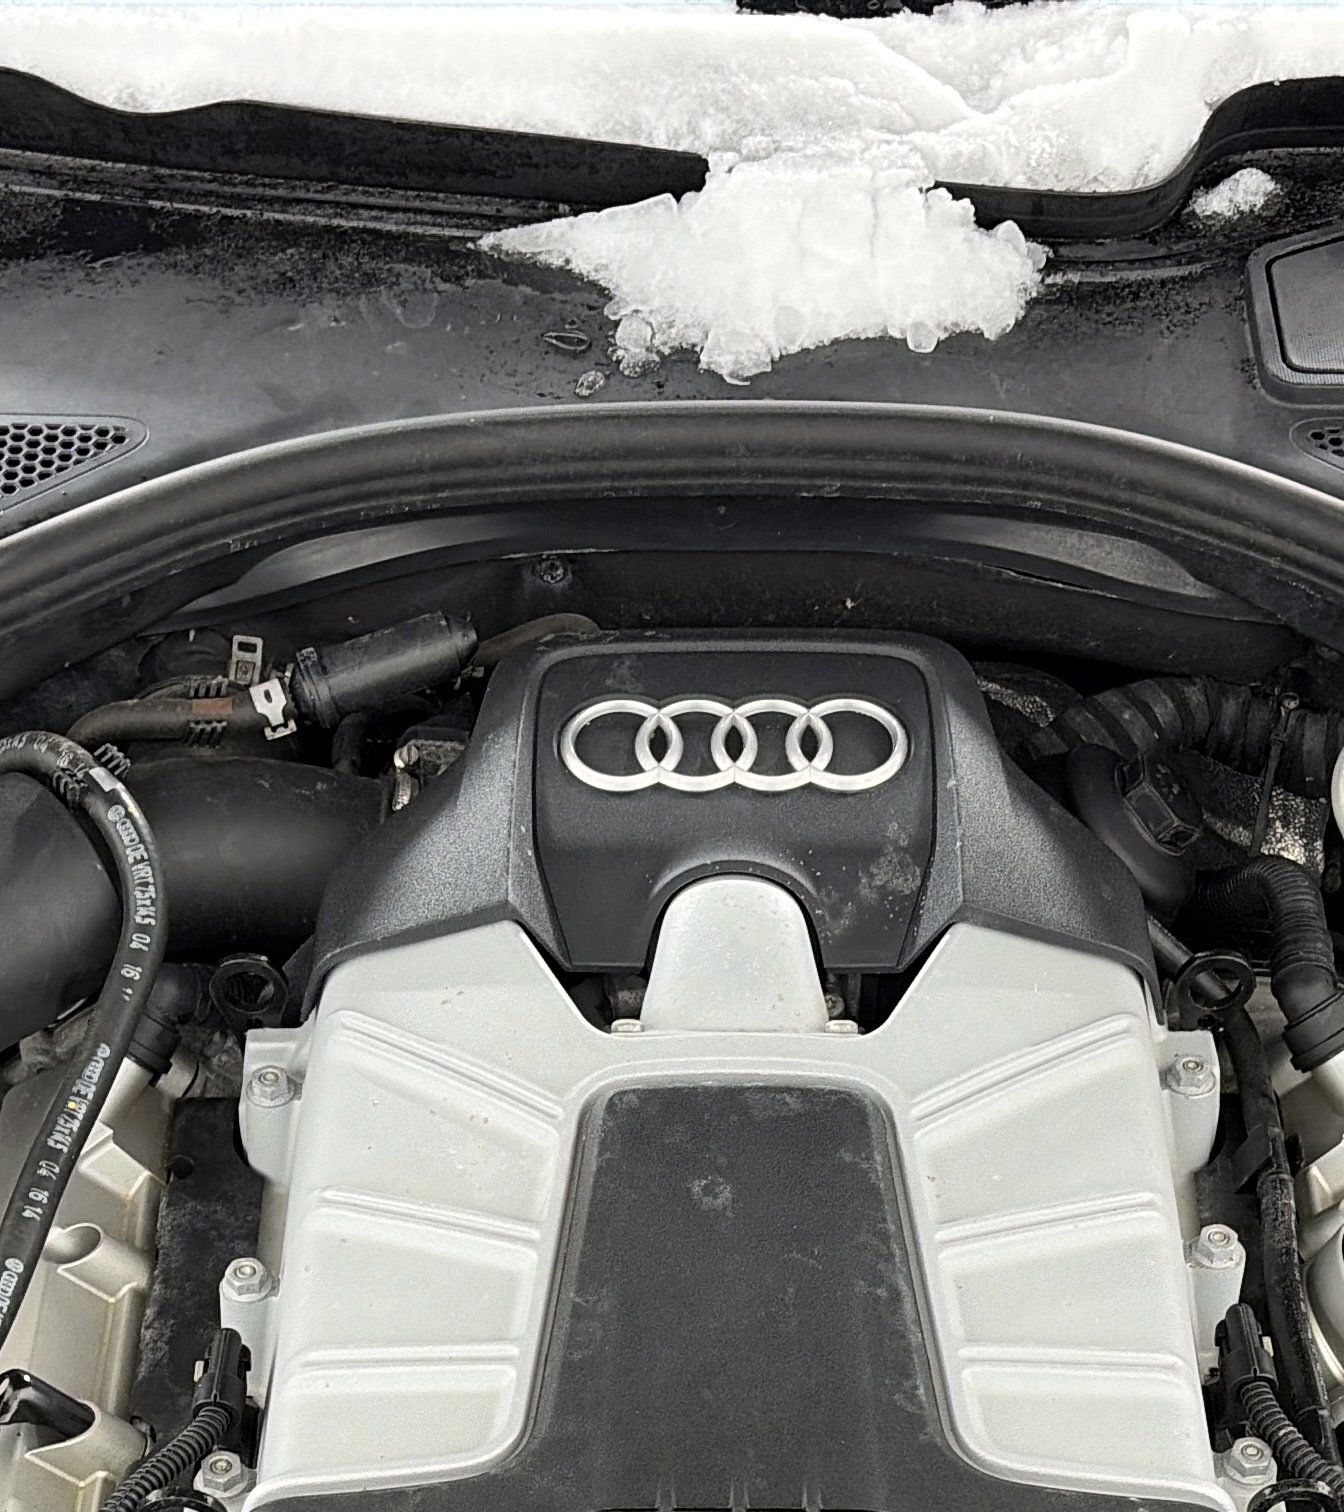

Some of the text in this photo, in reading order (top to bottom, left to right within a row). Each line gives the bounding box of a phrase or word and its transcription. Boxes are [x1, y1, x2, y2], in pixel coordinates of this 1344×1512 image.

[126, 843, 149, 864] DE
[131, 862, 155, 885] VRT
[129, 933, 151, 952] 04
[120, 964, 143, 981] 16
[72, 1079, 96, 1100] DE
[37, 1160, 60, 1180] 04
[28, 1188, 50, 1204] 16
[22, 1205, 43, 1221] 14
